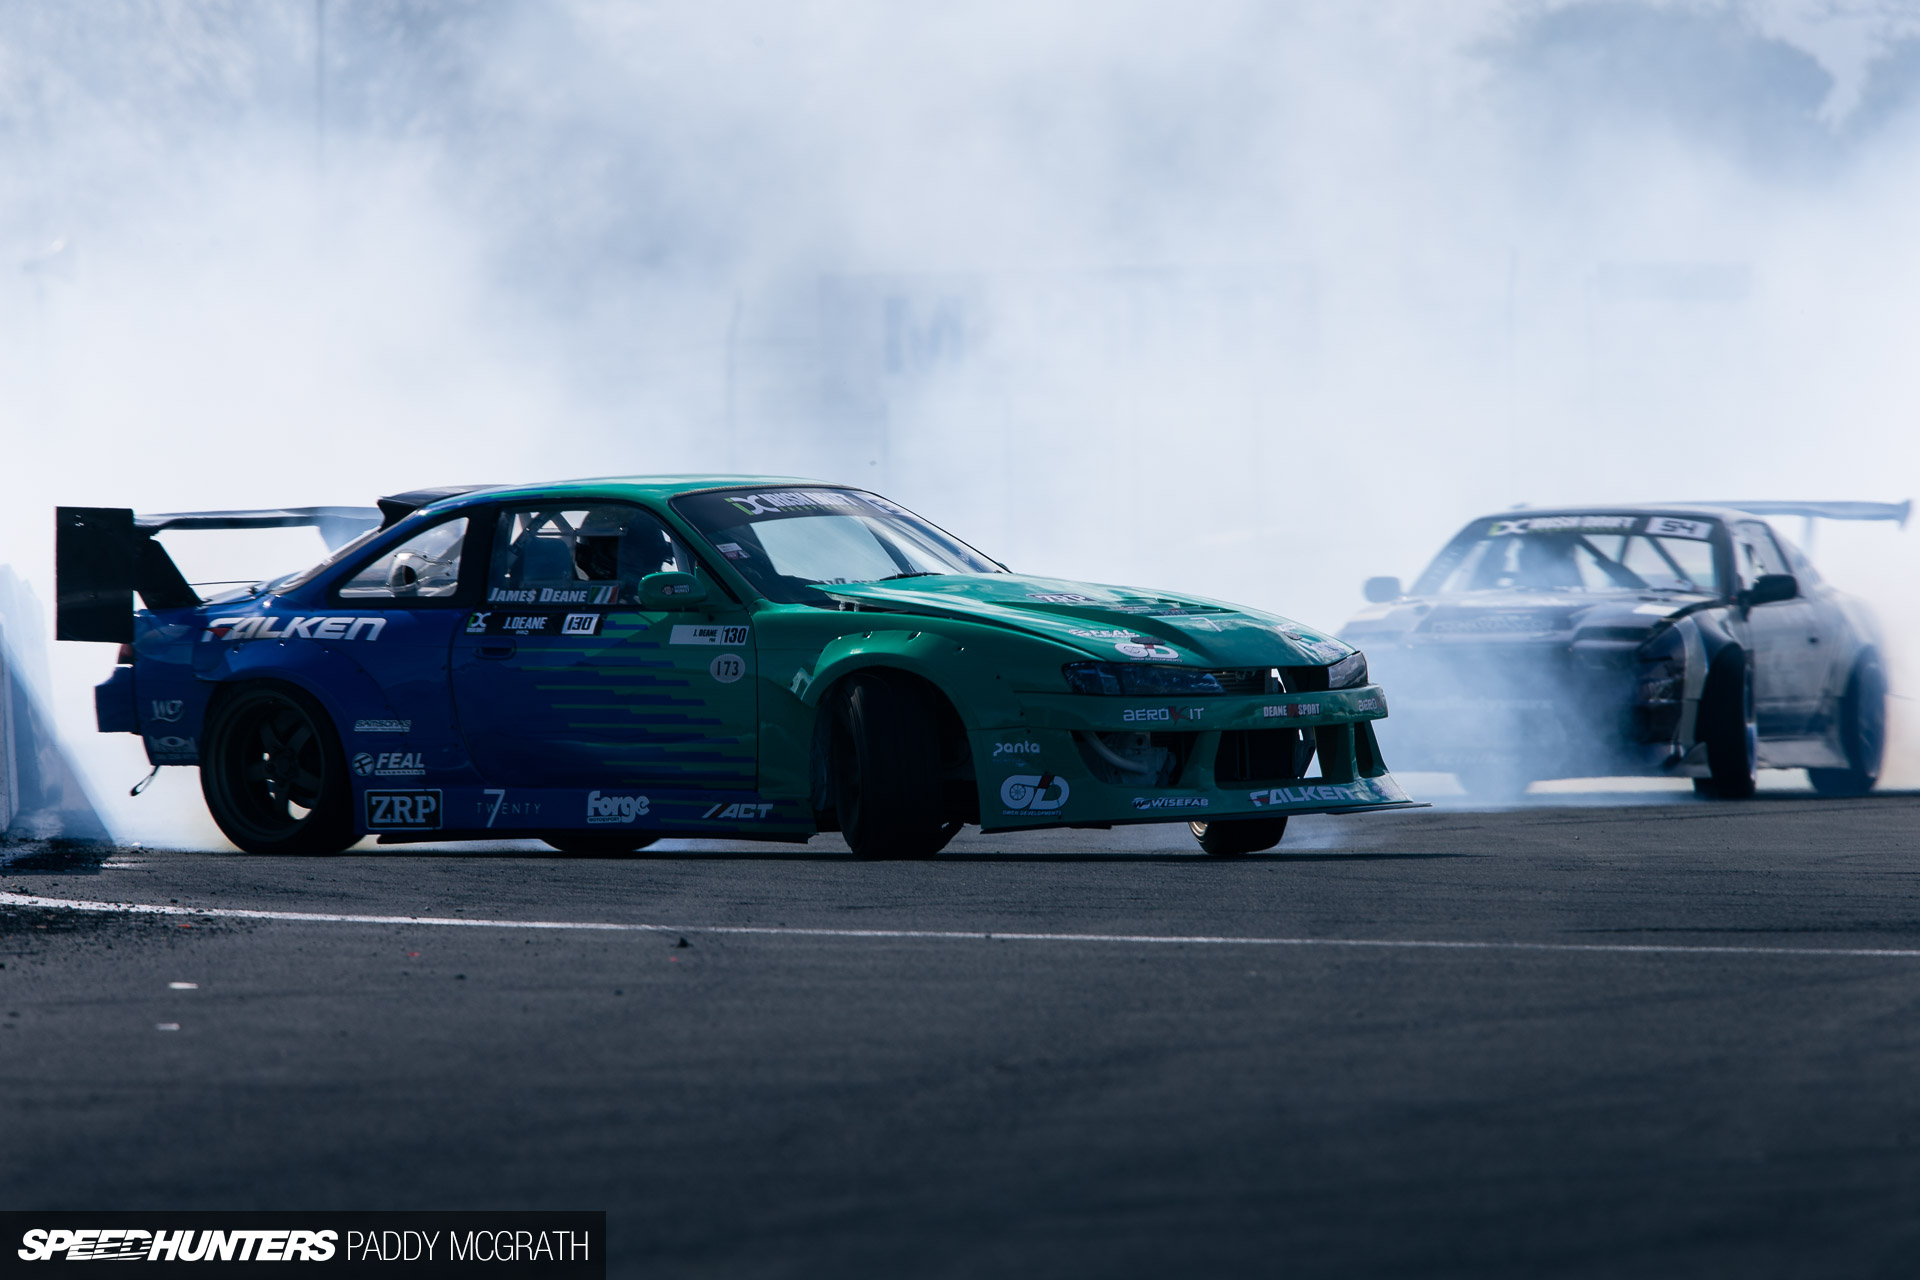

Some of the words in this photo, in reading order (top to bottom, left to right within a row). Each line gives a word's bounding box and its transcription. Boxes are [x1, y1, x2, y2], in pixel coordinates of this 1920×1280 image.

[202, 616, 387, 643] FALKEN
[567, 616, 593, 631] 130
[723, 627, 747, 644] 130
[716, 661, 739, 676] 173
[992, 740, 1040, 757] panta
[376, 753, 425, 769] FEAL
[1152, 797, 1209, 808] WISEFAB
[1250, 786, 1356, 807] FALKEN
[371, 795, 437, 824] ZRP
